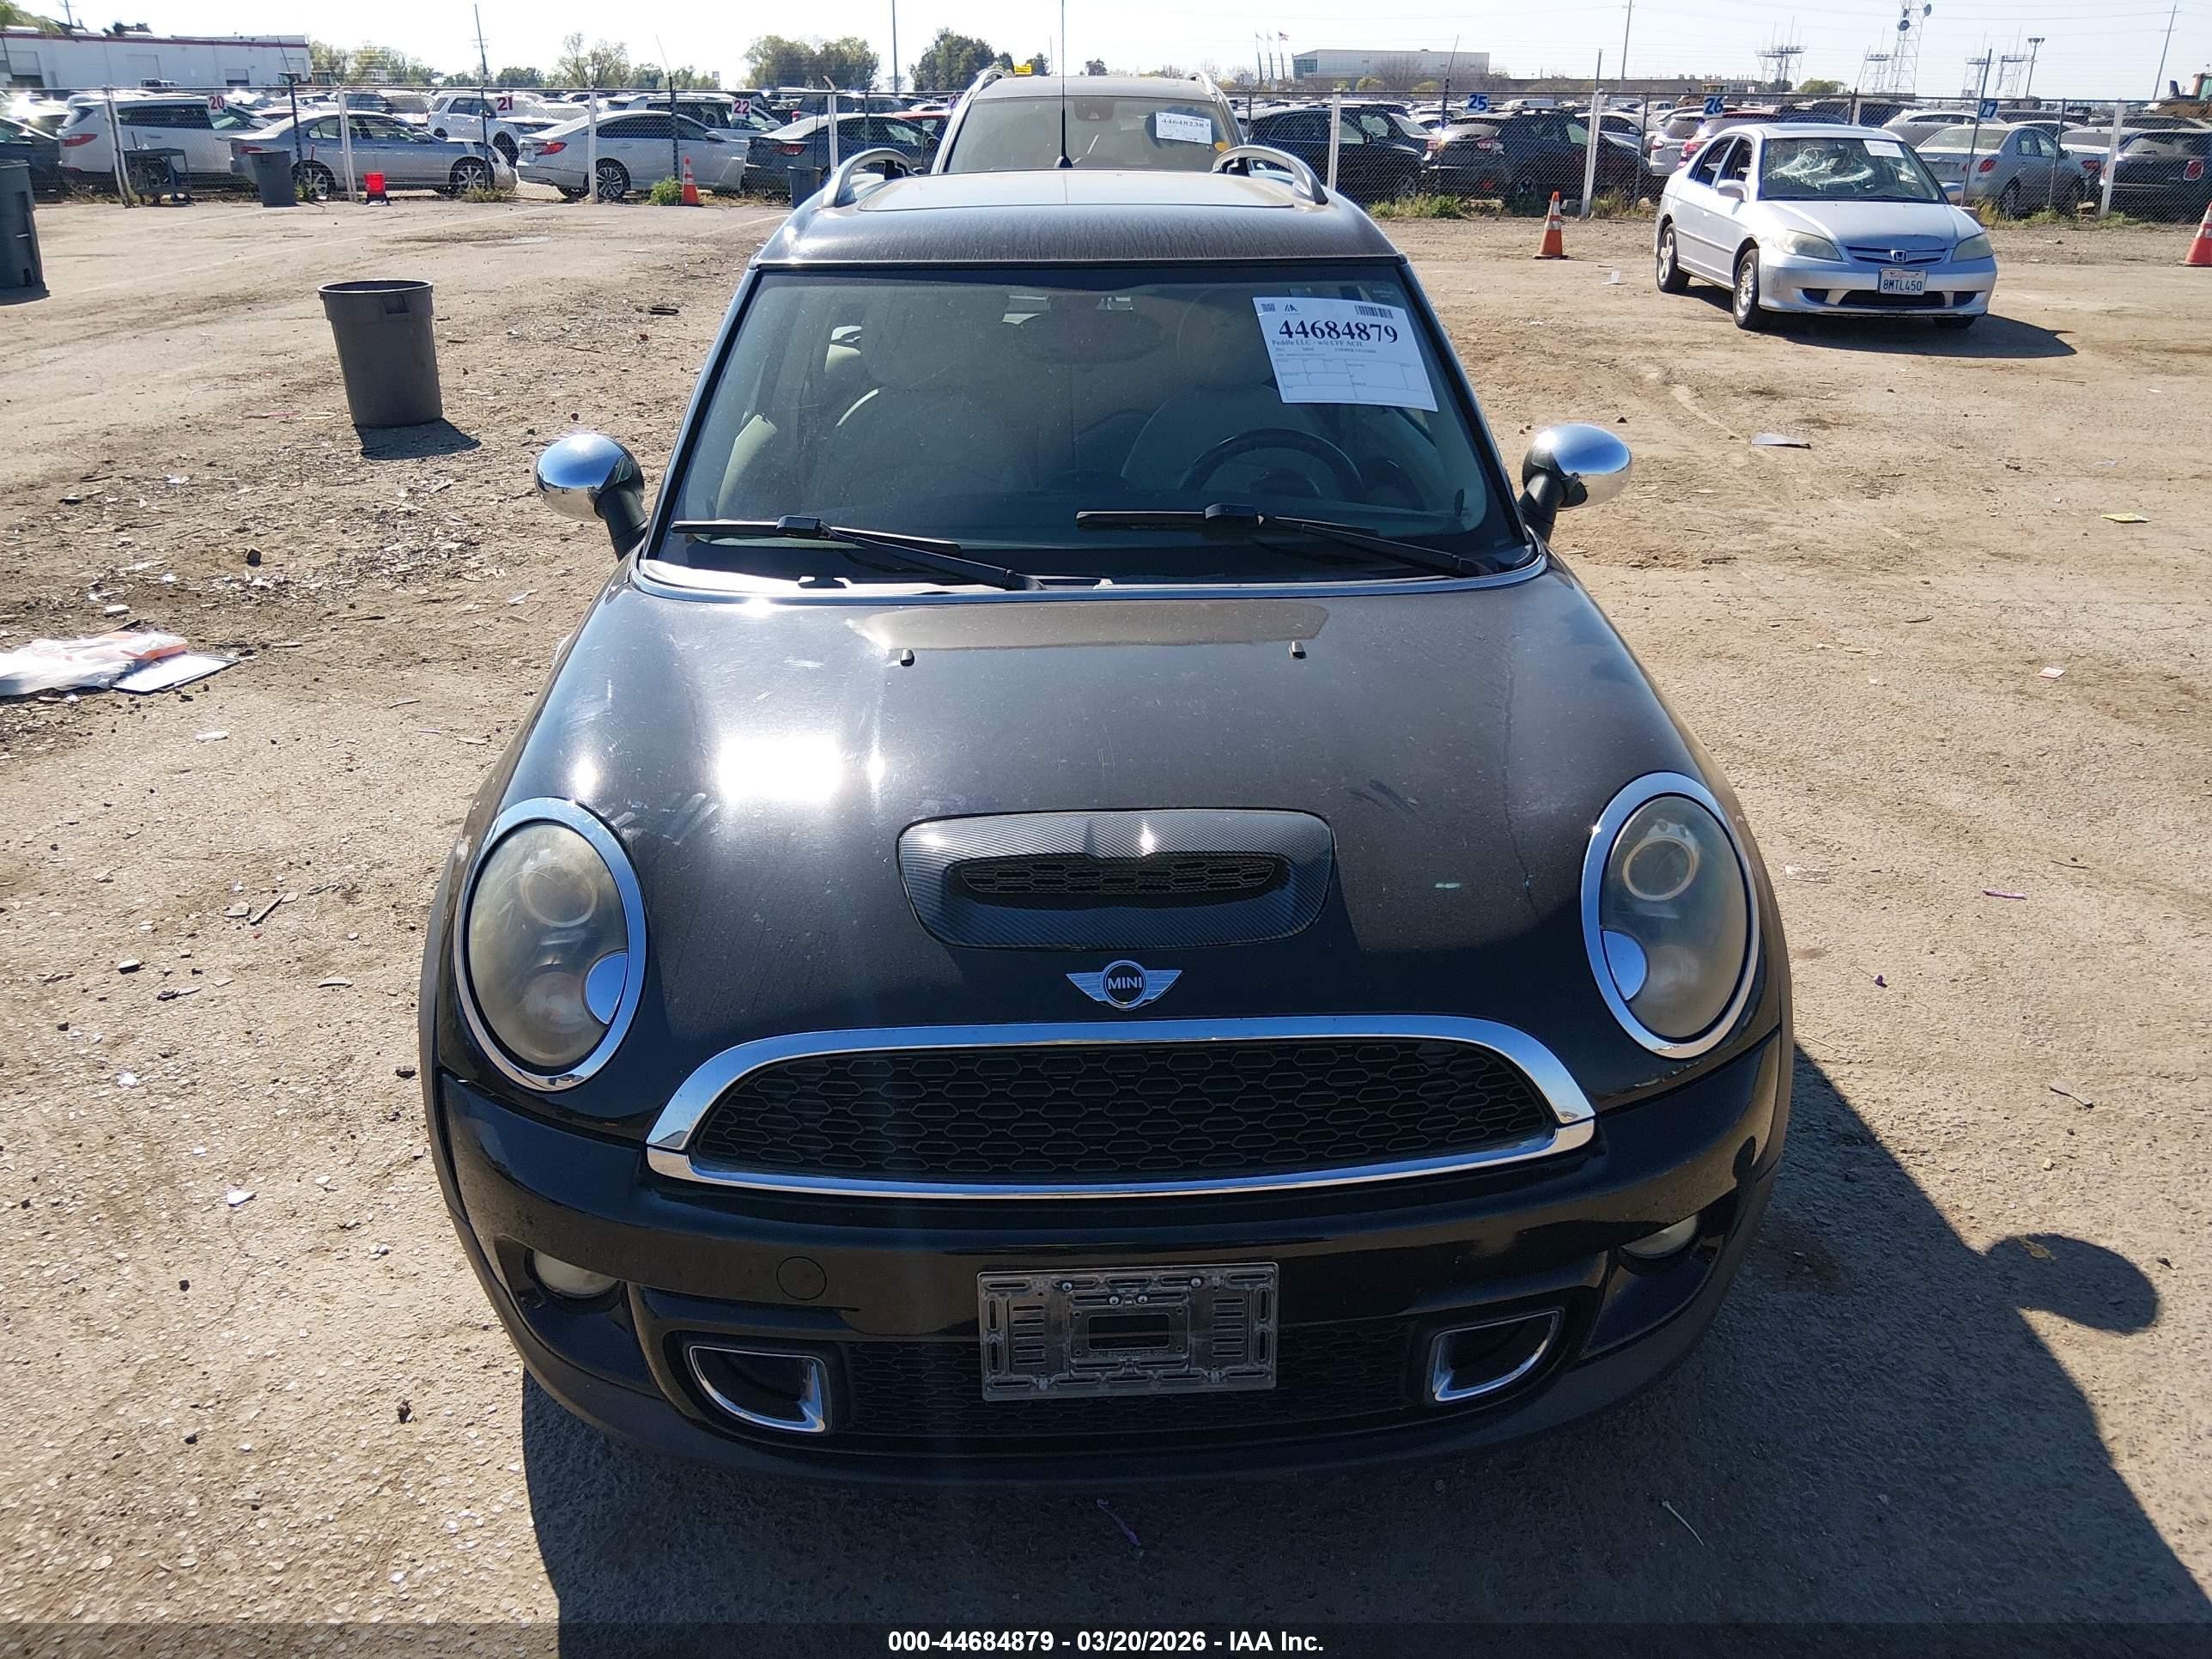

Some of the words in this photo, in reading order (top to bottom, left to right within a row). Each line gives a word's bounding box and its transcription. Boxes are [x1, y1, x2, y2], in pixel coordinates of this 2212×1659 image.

[209, 95, 225, 110] 20
[496, 96, 514, 112] 21
[733, 100, 750, 114] 22
[950, 94, 963, 110] 2
[1468, 94, 1488, 112] 25
[1704, 96, 1723, 115] 26
[1883, 279, 1923, 292] 8MTL450
[1279, 319, 1398, 343] 44684879
[1108, 976, 1143, 990] MINI
